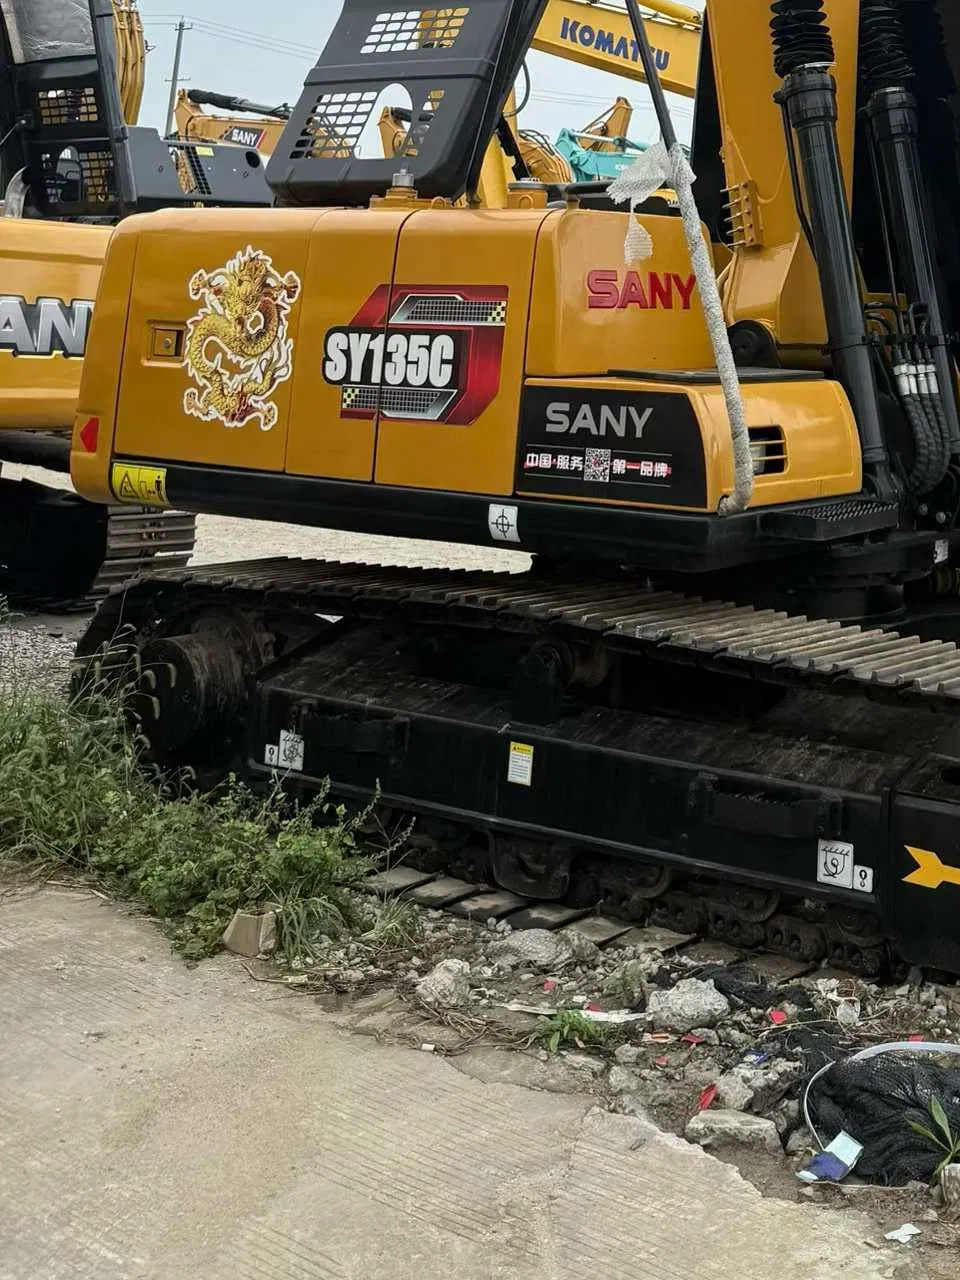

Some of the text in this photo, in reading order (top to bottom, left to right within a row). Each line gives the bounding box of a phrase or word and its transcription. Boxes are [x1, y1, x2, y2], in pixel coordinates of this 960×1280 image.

[560, 16, 670, 71] KOMATU
[231, 128, 258, 146] SANY
[587, 269, 697, 310] SANY
[325, 332, 454, 387] SY135C
[545, 402, 654, 438] SANY
[612, 458, 670, 478] 第一品牌
